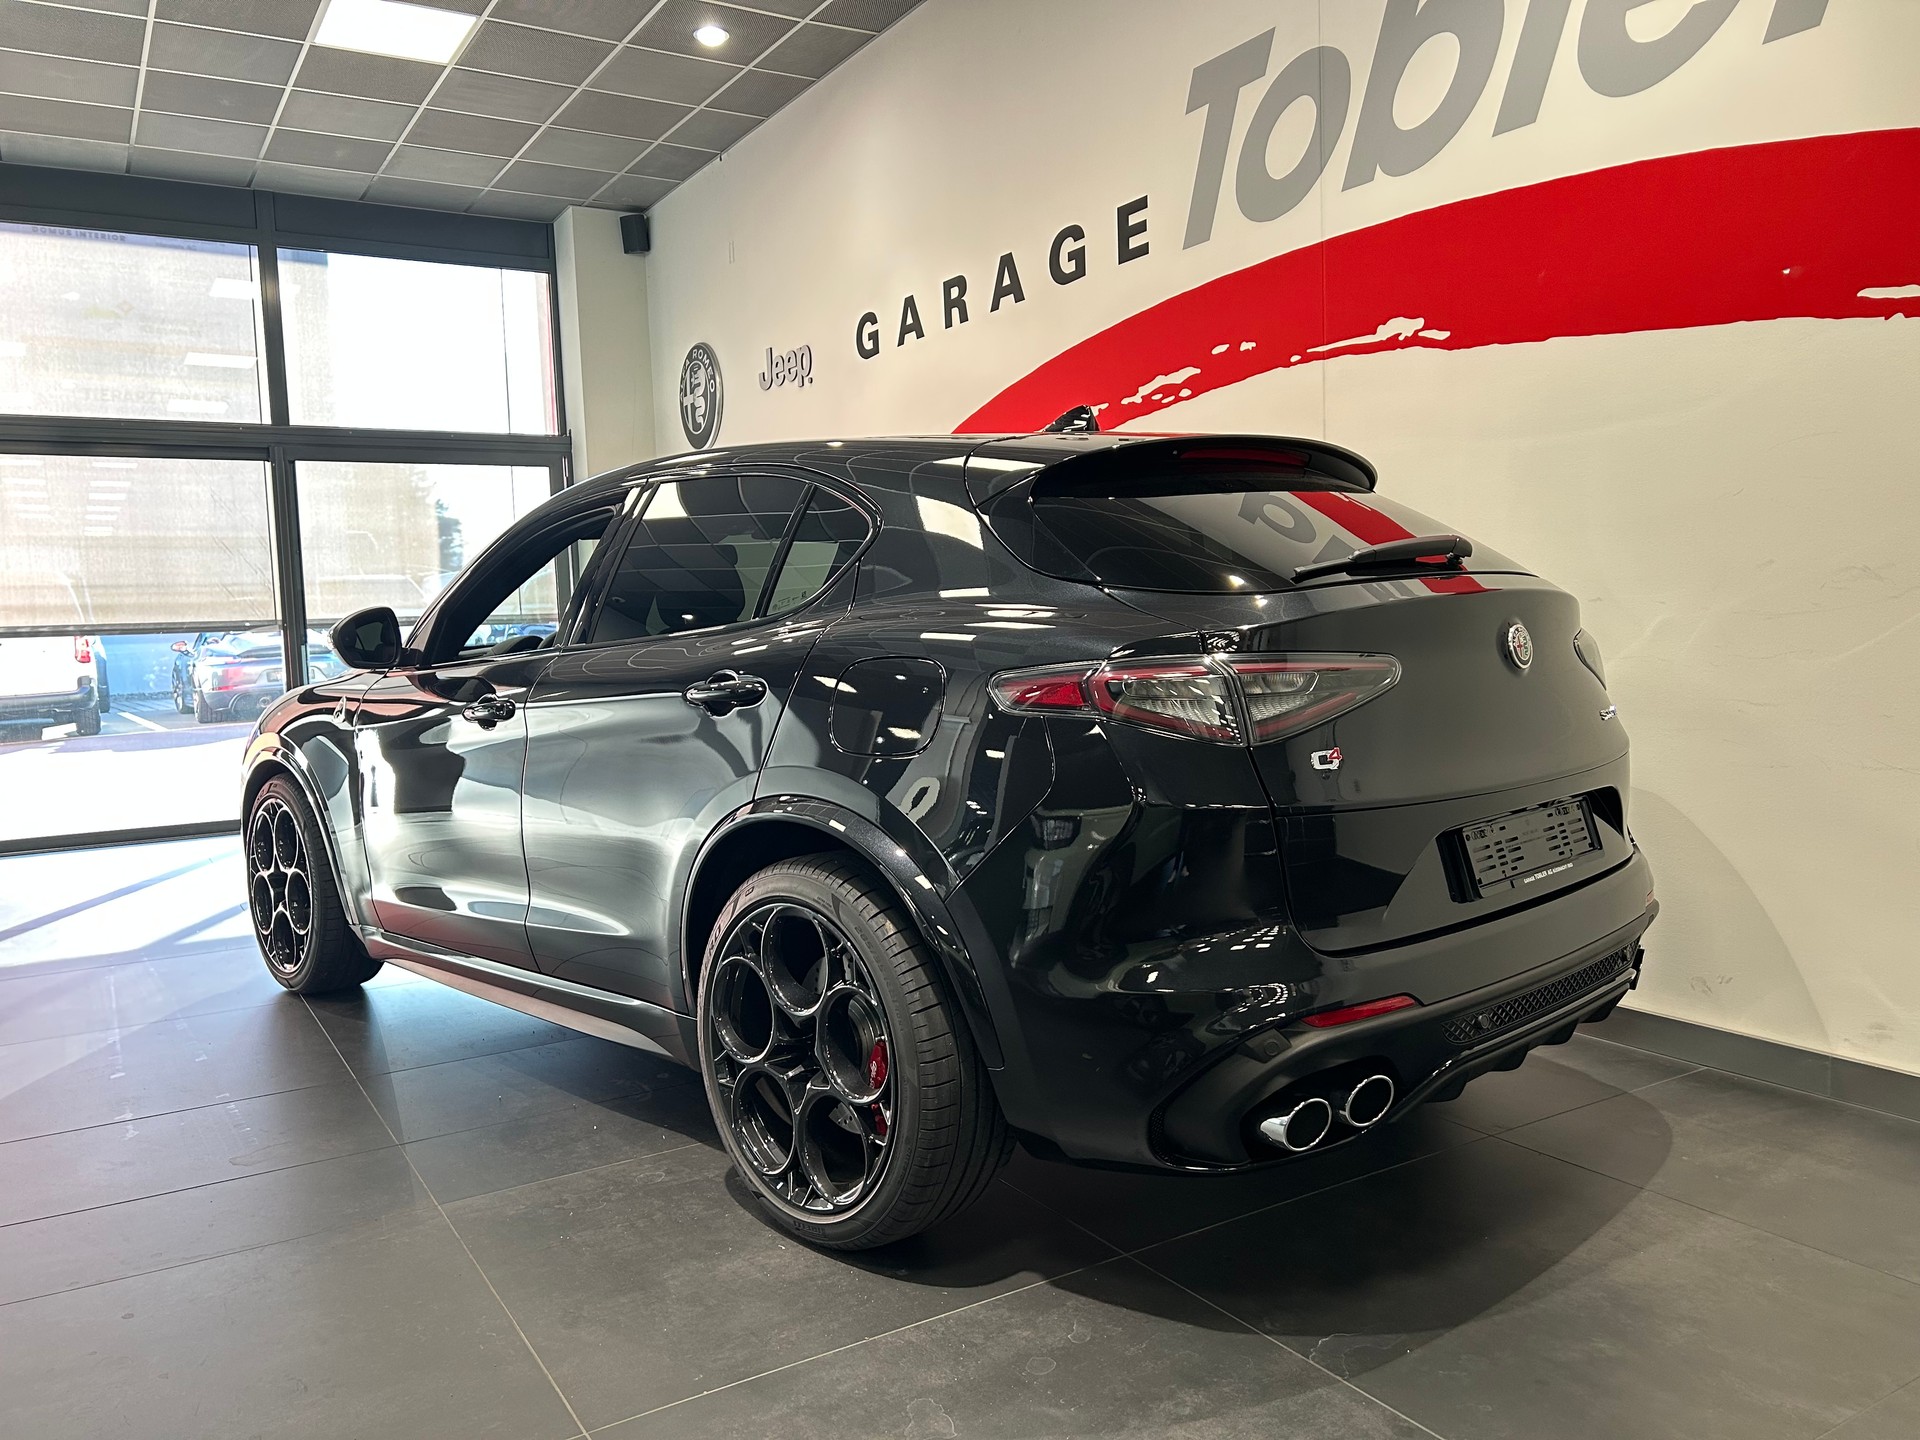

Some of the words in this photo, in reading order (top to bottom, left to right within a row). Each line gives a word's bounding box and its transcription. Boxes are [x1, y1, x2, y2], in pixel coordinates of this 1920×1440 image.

[75, 230, 126, 242] INTERIOR
[856, 194, 1149, 360] GARAGE
[692, 349, 716, 393] ROMEO
[1311, 747, 1342, 769] Q4
